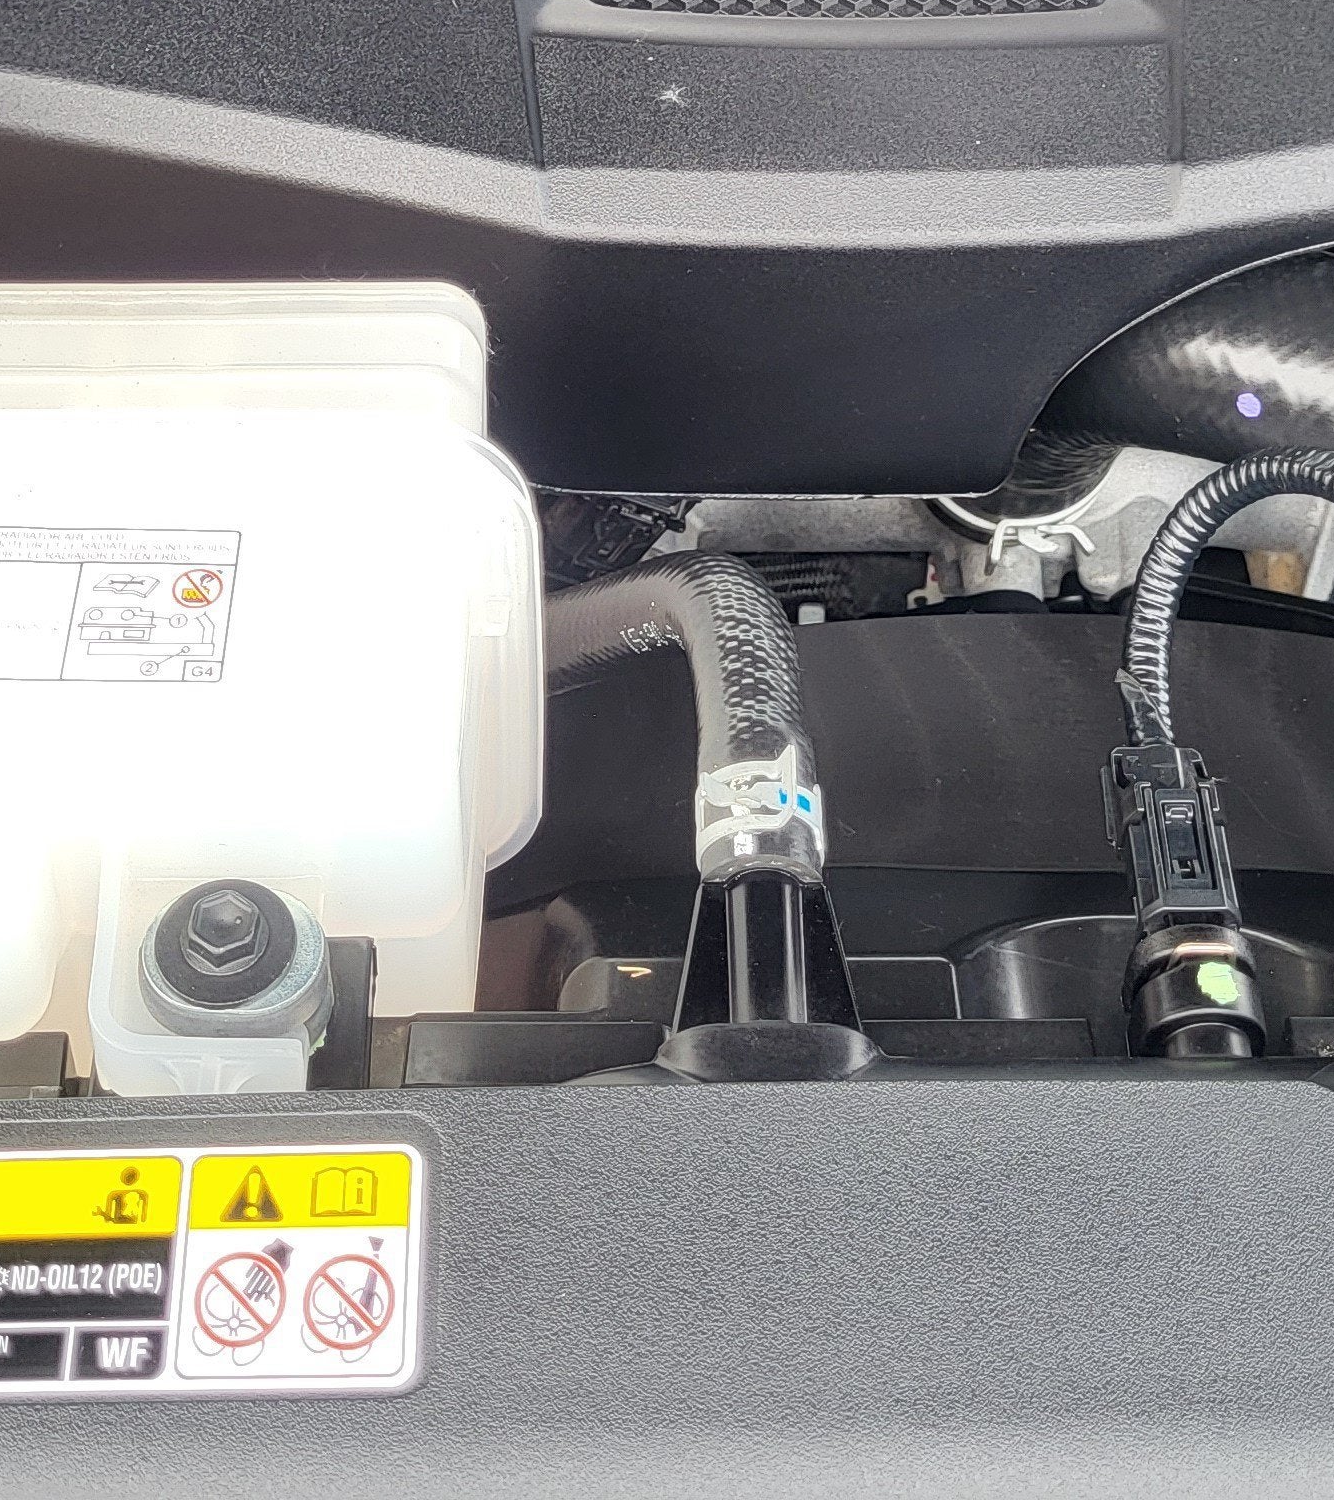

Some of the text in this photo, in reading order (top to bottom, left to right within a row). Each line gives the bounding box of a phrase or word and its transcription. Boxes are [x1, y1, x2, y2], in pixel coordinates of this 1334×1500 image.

[191, 665, 214, 677] G4
[10, 1263, 104, 1291] ND-OIL12
[108, 1262, 162, 1295] (POE)
[99, 1336, 149, 1369] WF
